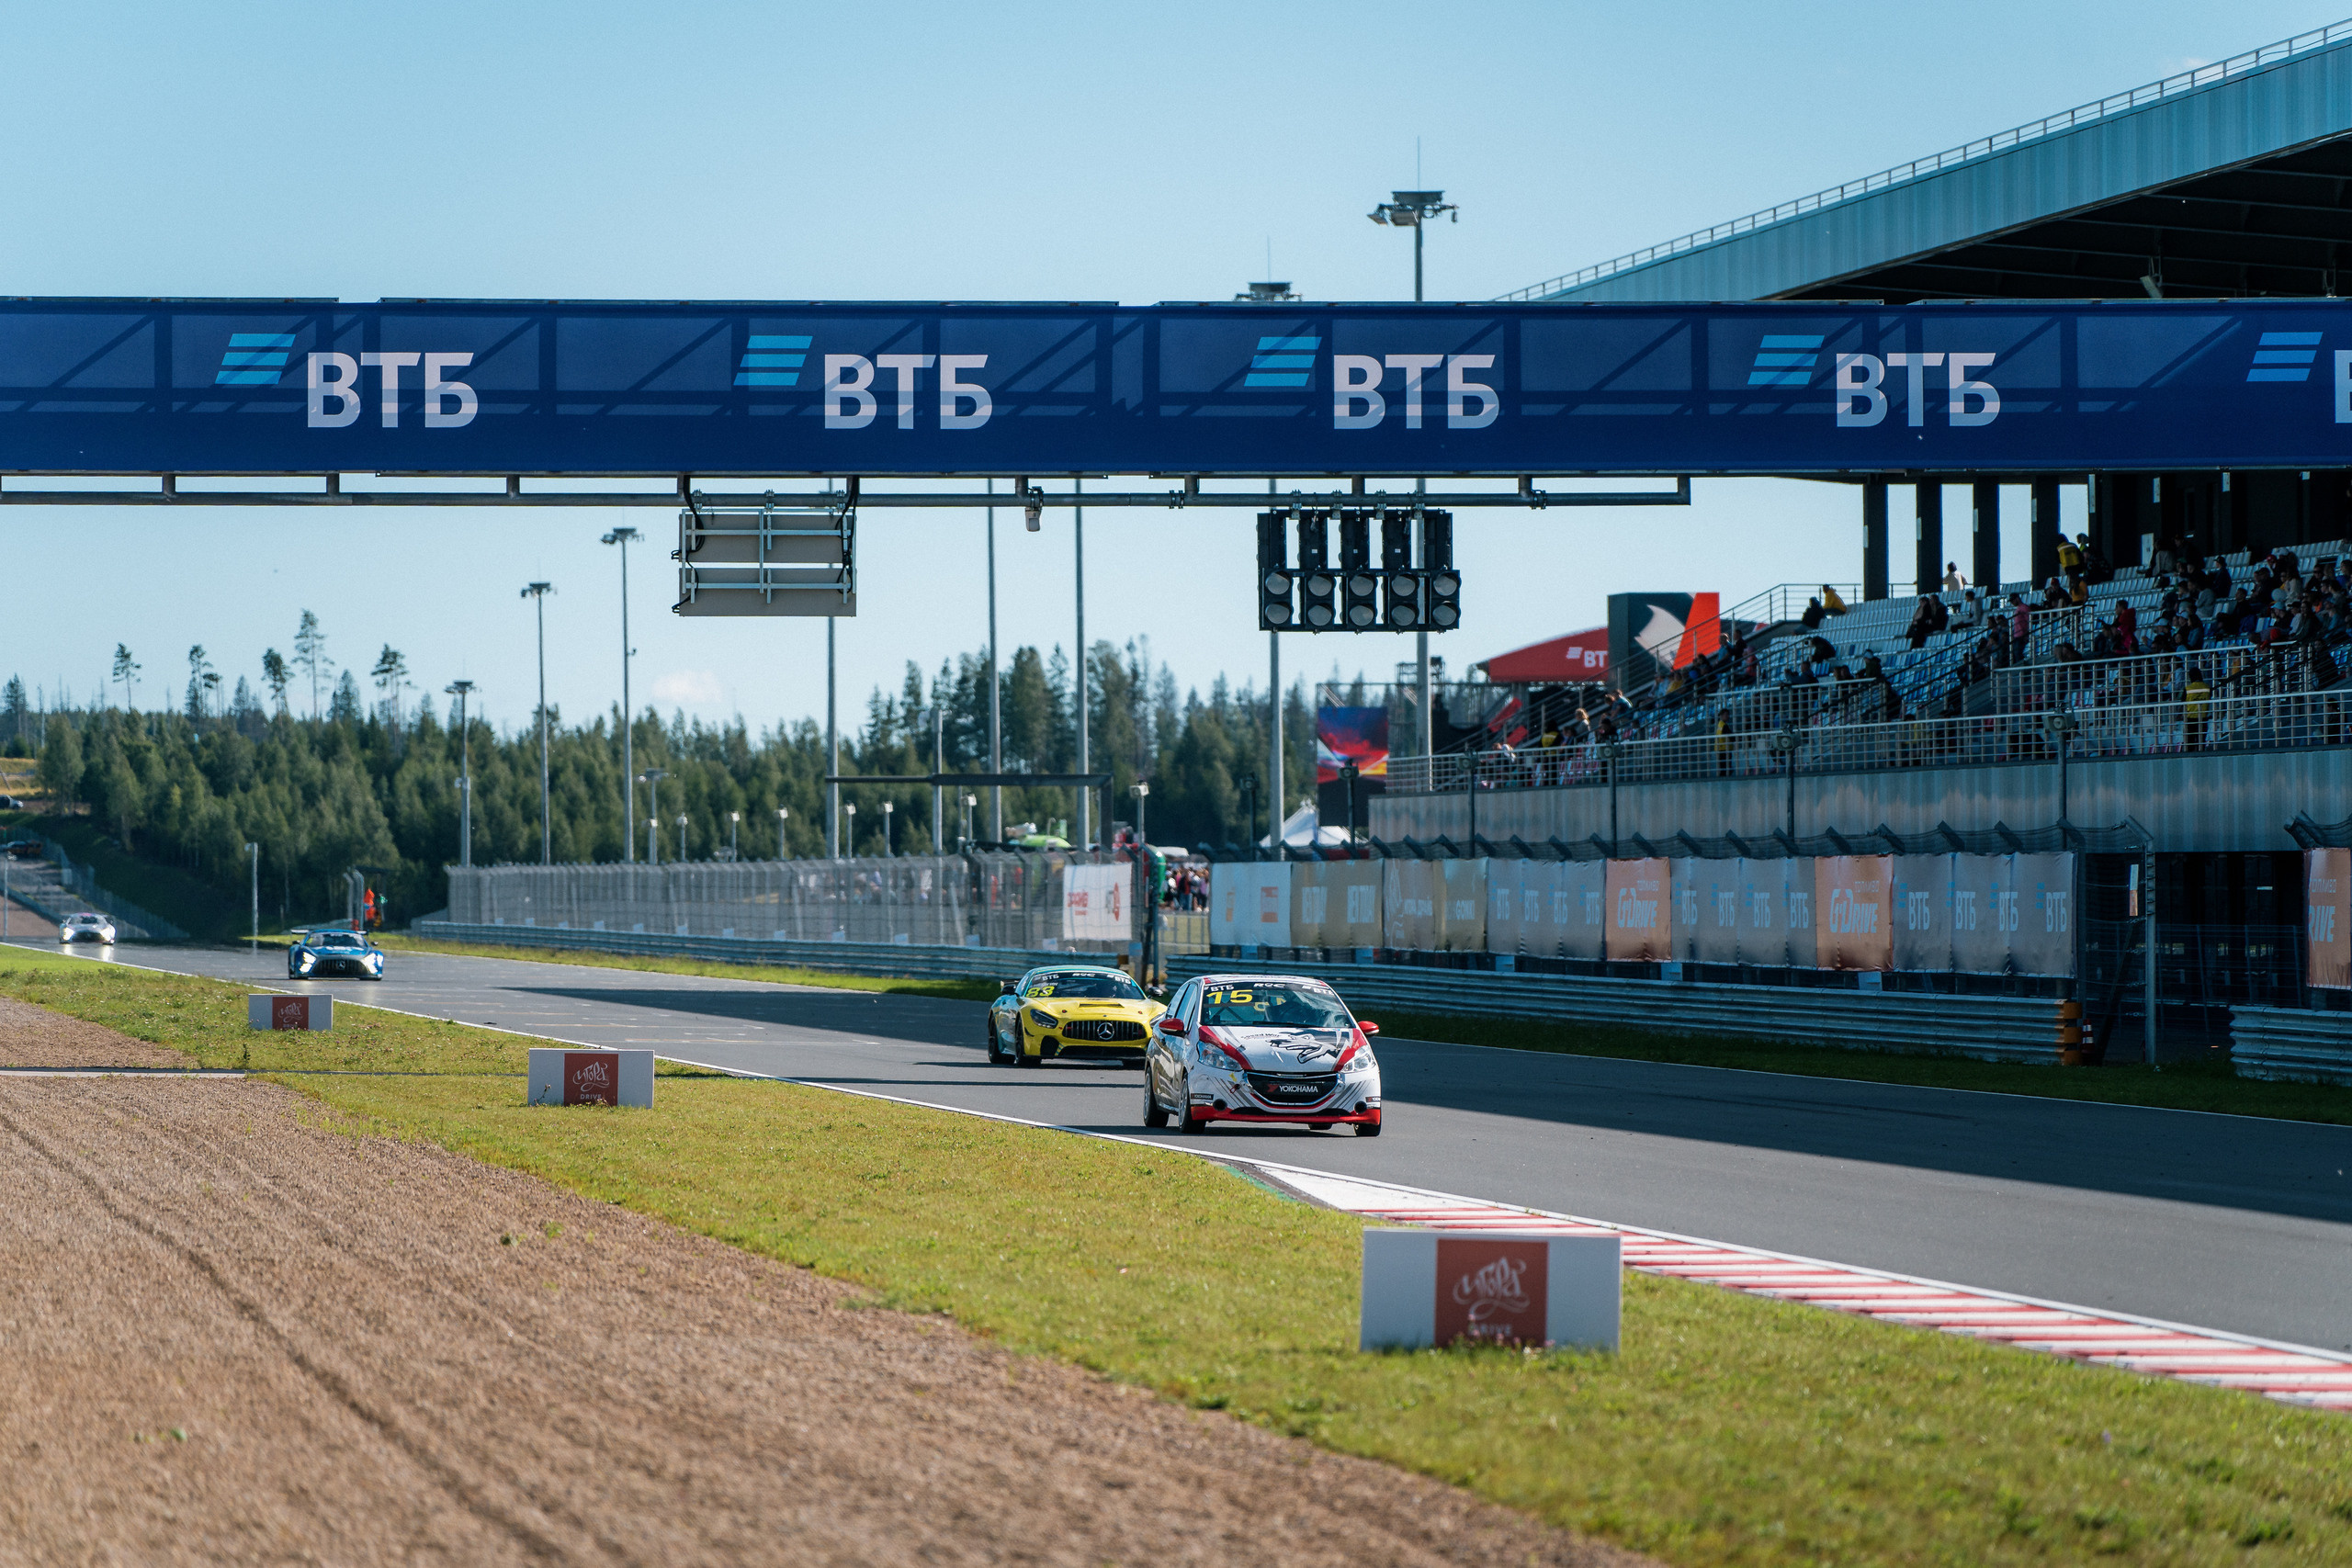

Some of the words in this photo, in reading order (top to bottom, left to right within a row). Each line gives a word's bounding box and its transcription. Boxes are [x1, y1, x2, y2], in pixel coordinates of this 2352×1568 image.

[307, 353, 479, 428] ВТБ
[824, 355, 993, 430] ВТБ
[1333, 355, 1500, 429] ВТБ
[1837, 353, 2001, 427] ВТБ
[1584, 650, 1608, 668] ВТ
[1497, 888, 1510, 919] ВТБ
[1524, 890, 1539, 922] ВТБ
[1554, 891, 1568, 924] ВТБ
[1586, 891, 1600, 924] ВТБ
[1682, 890, 1698, 925] ВТБ
[1718, 891, 1735, 927] ВТБ
[1754, 892, 1770, 928] ВТБ
[1790, 892, 1809, 928] ВТБ
[1908, 891, 1929, 931] ВТБ
[1955, 891, 1976, 931] ВТБ
[1998, 891, 2018, 931] ВТБ
[2046, 891, 2067, 932] ВТБ
[1206, 989, 1253, 1004] 15
[1279, 1085, 1318, 1093] YOKOHAMA
